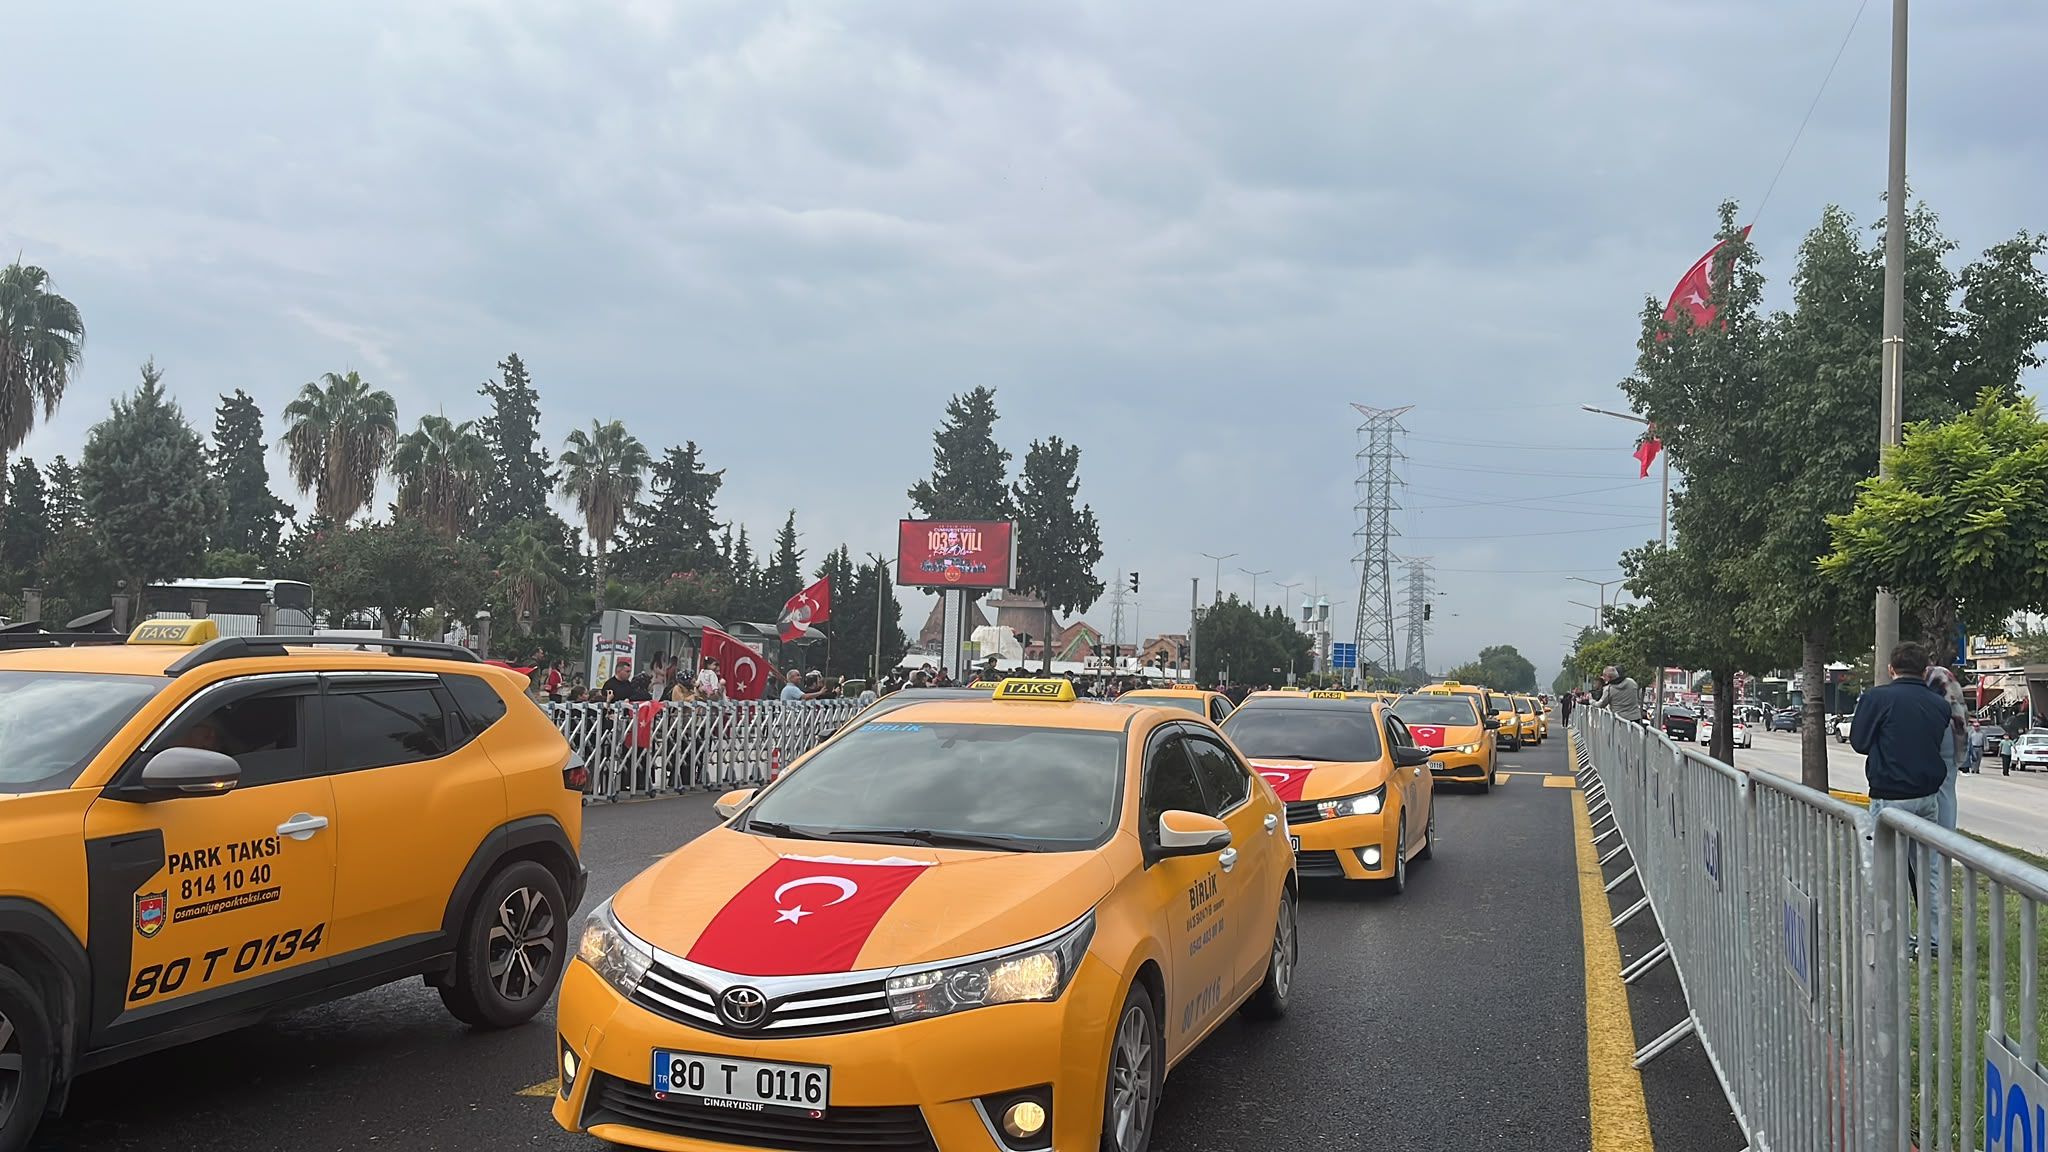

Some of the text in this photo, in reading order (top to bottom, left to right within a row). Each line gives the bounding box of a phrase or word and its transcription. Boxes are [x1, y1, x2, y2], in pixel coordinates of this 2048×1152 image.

[960, 532, 982, 551] YILI
[168, 846, 221, 875] PARK
[181, 863, 271, 899] 814 10 40
[1189, 872, 1217, 911] BİRLİK
[175, 889, 279, 919] osmaniyeparktaksi.com
[128, 922, 326, 1002] 80 T 0134
[657, 1074, 668, 1084] TR
[670, 1058, 822, 1104] 80 T 0116
